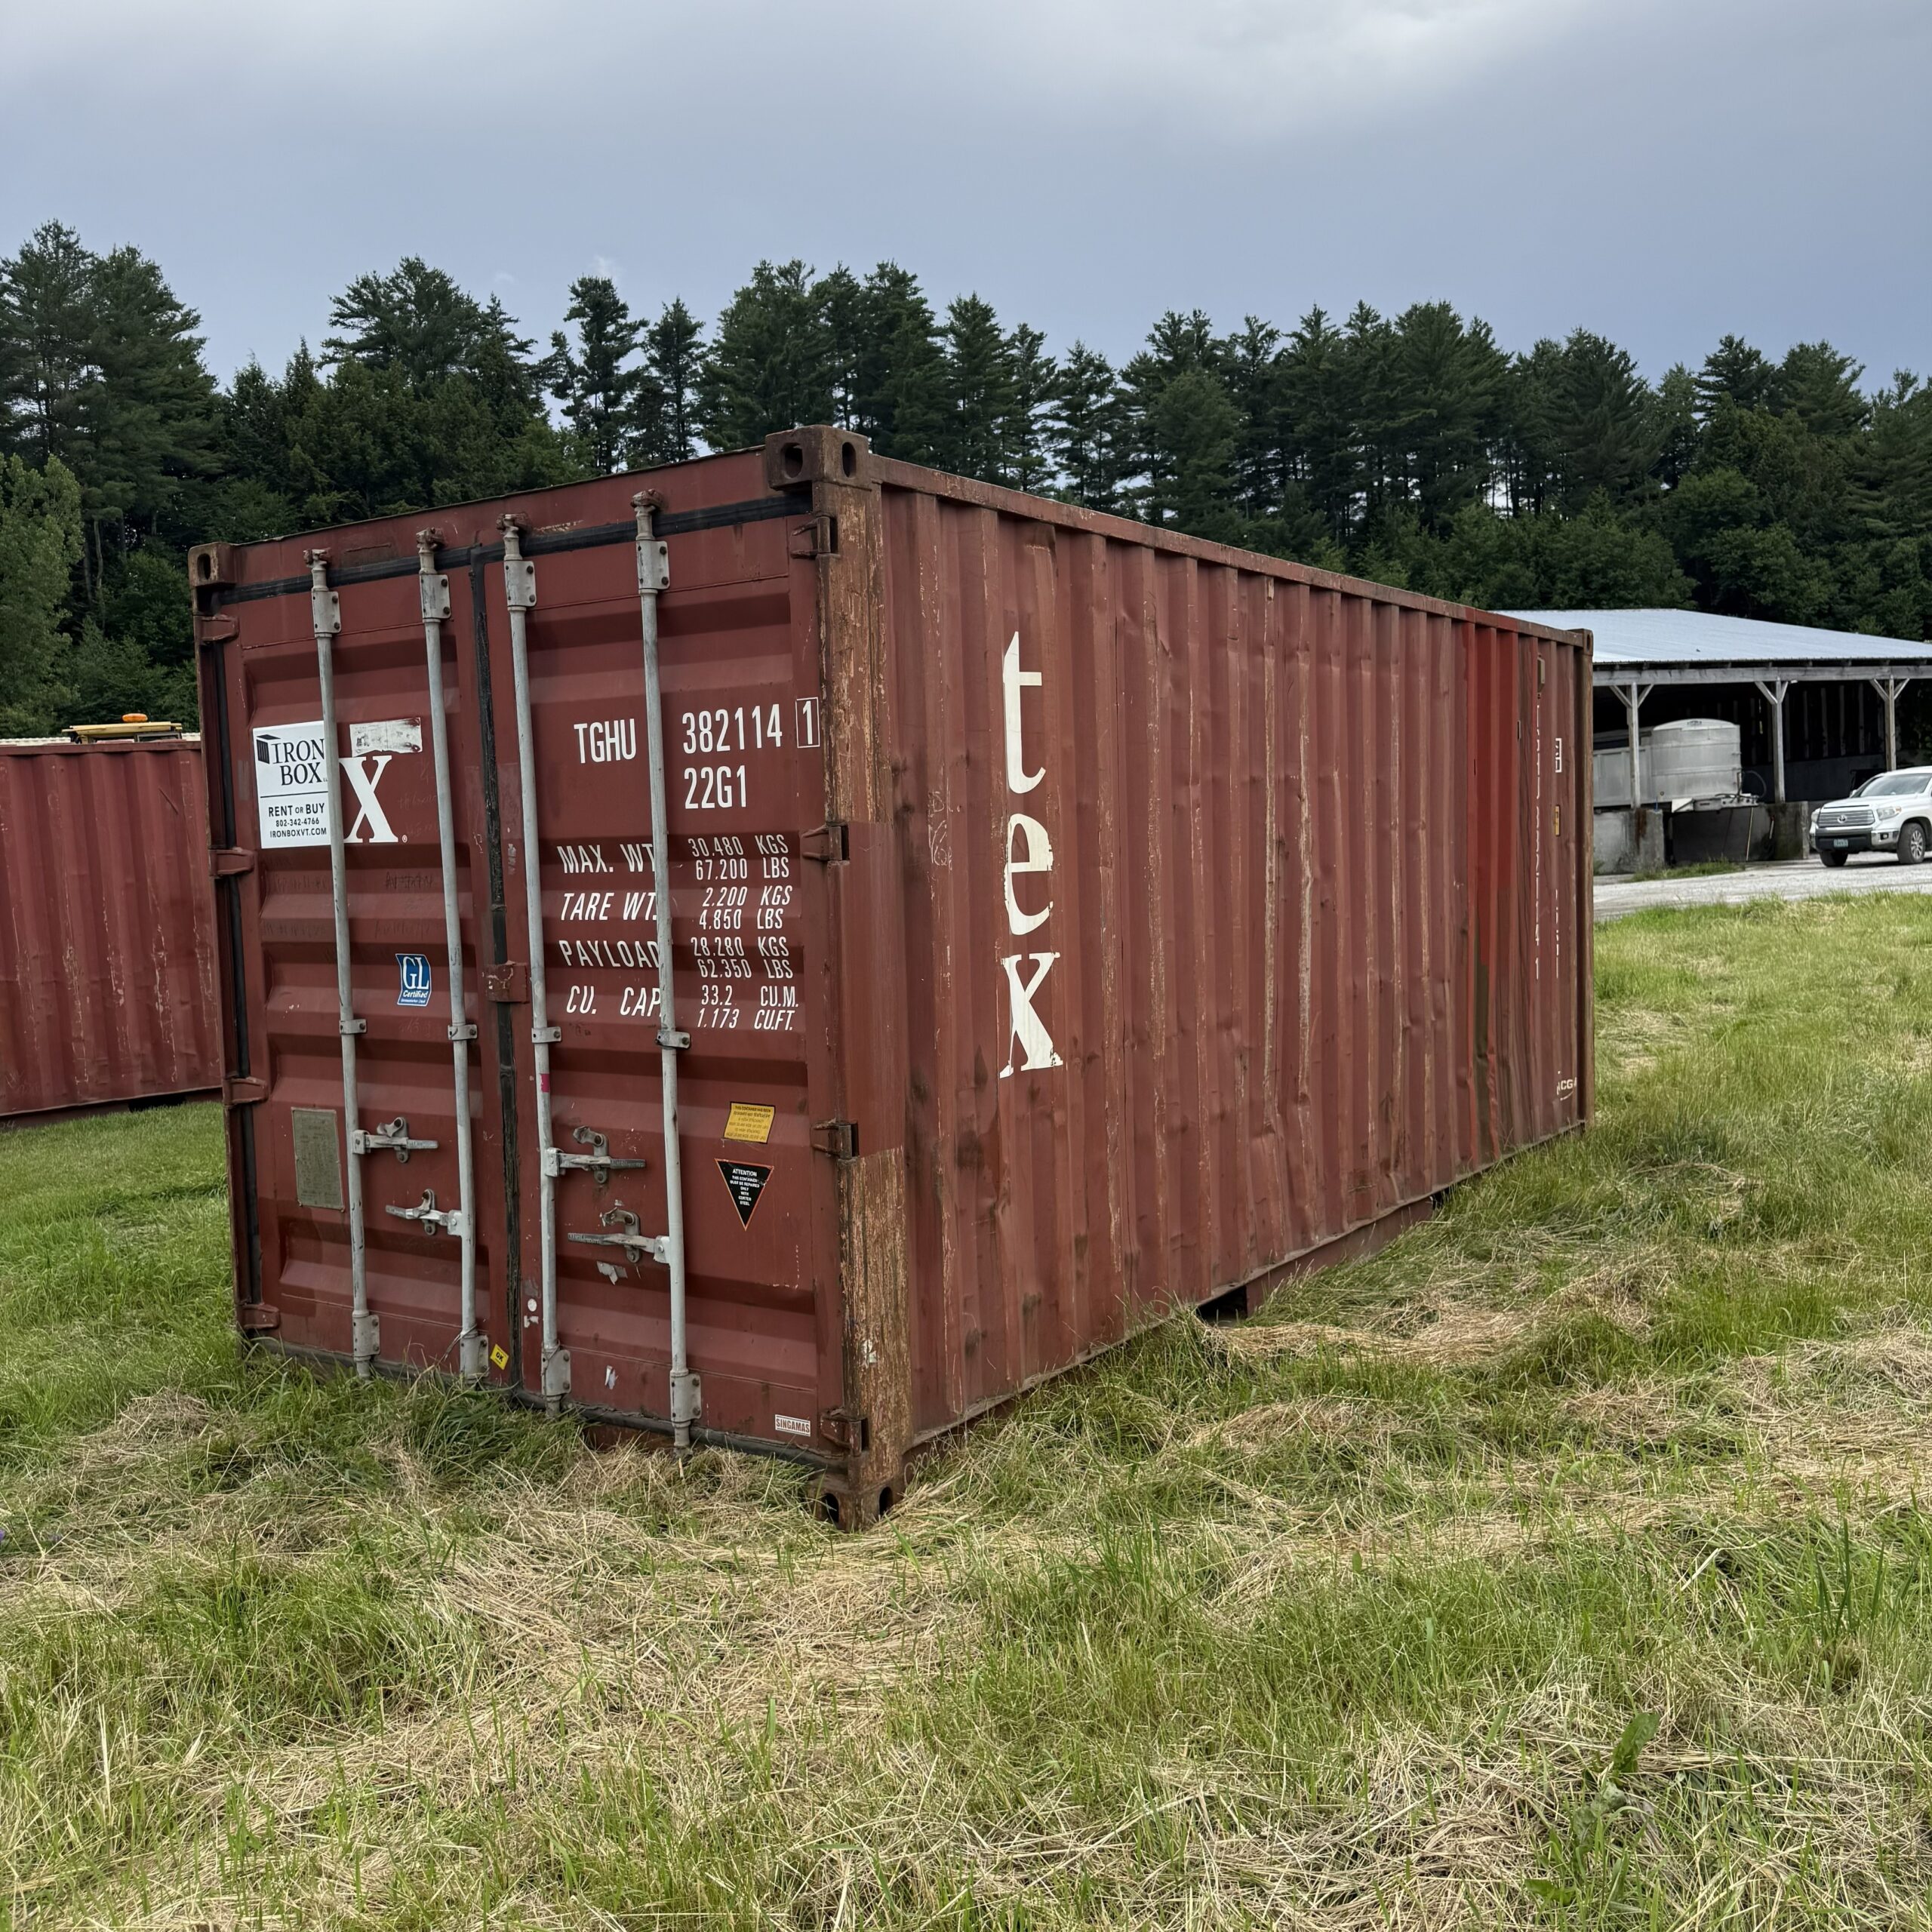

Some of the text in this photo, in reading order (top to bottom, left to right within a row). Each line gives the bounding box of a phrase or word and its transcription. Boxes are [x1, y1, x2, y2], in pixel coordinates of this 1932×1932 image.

[574, 718, 636, 763] TGHU
[682, 703, 783, 754] 382114
[271, 739, 325, 764] IRON
[280, 762, 322, 786] BOX
[684, 765, 746, 809] 22G1
[269, 805, 293, 817] RENT
[306, 802, 325, 814] BUY
[270, 827, 327, 838] IRONBOXVT.COM
[275, 817, 319, 827] 802-342-4766
[557, 844, 614, 873] MAX.
[755, 834, 789, 854] KGS
[696, 857, 789, 881] 67,200 LBS
[561, 885, 792, 921] TARE WT. 2,200 KGS
[699, 908, 783, 930] 4,850 LBS
[558, 940, 659, 968] PAYLOAD
[758, 936, 789, 956] KGS
[402, 956, 429, 989] GL
[764, 959, 793, 979] LBS
[403, 989, 428, 998] Certified
[567, 986, 597, 1014] CU.
[701, 985, 733, 1006] 33.2
[761, 986, 798, 1008] CU.M.
[697, 1008, 795, 1030] 1,173 CU.FT.
[732, 1168, 757, 1177] ATTENTION
[776, 1418, 810, 1433] SINGAMAS
